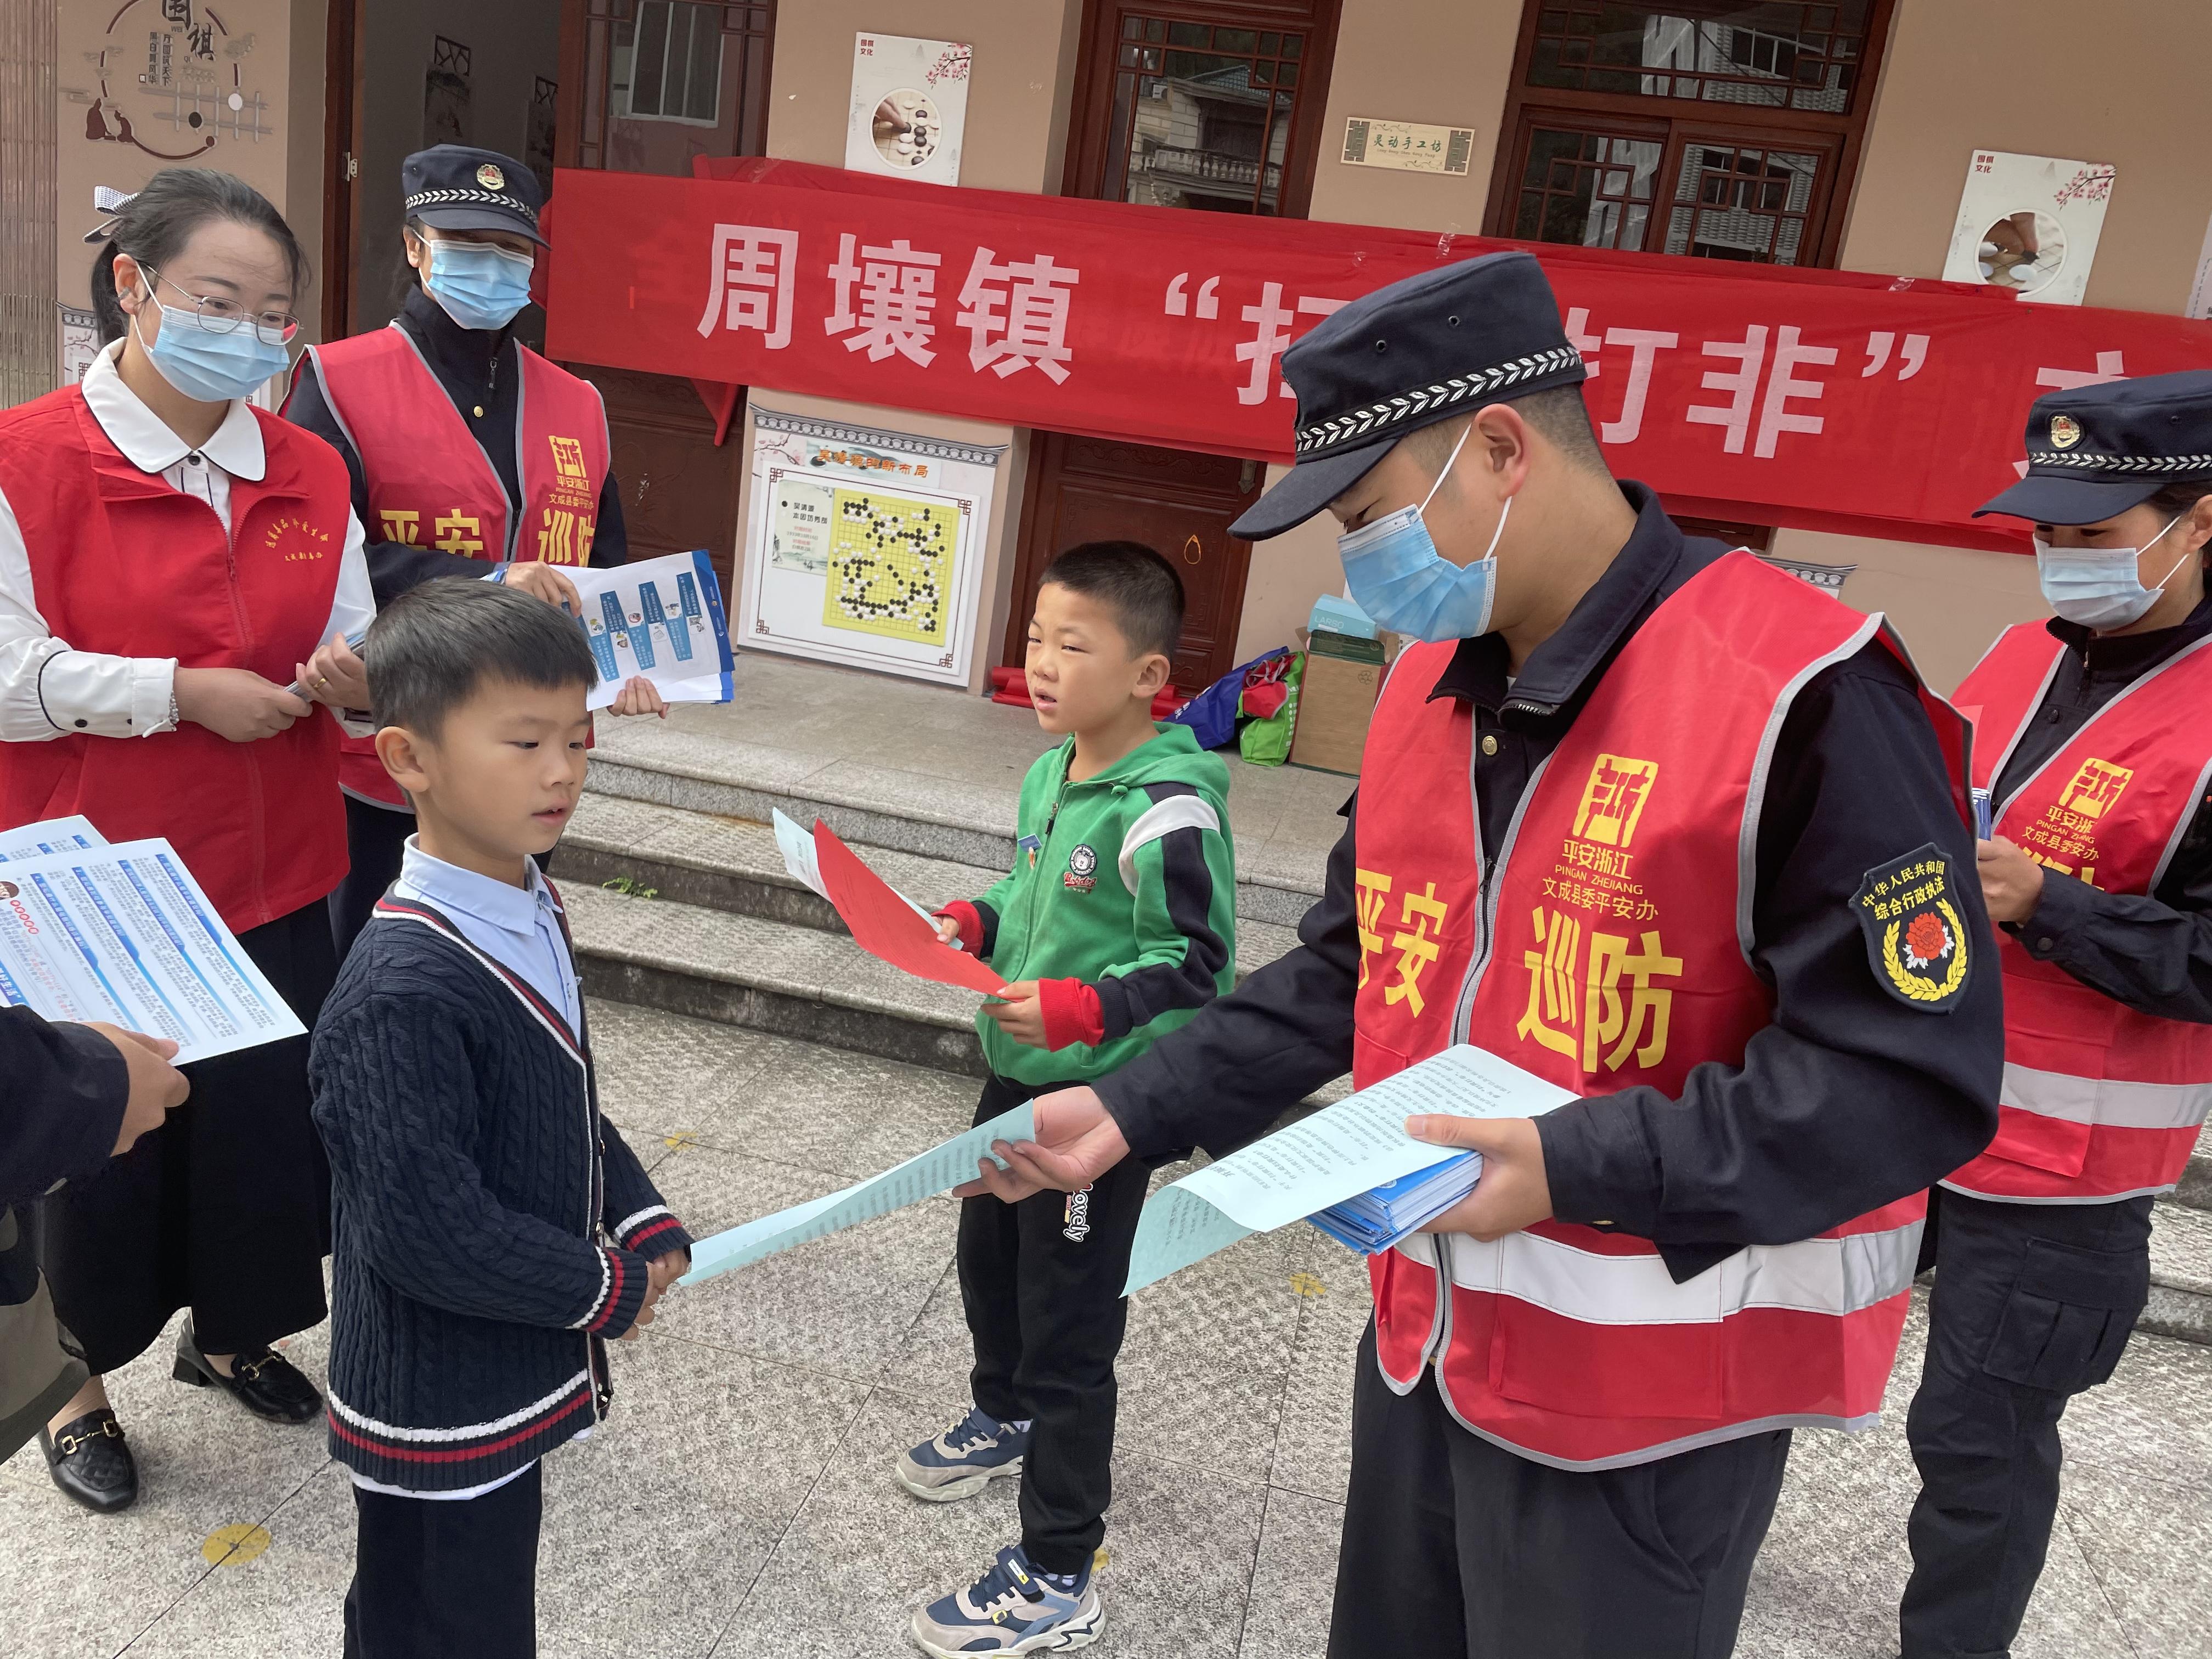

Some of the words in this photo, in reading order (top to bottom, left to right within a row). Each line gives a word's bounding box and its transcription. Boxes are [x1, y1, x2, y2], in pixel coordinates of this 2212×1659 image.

[1374, 134, 1442, 152] 灵动手工坊
[1975, 165, 1991, 173] 文化
[697, 223, 1080, 386] 周壤镇
[2036, 819, 2069, 836] PINGAN
[1555, 864, 1587, 883] PINGAN
[1591, 873, 1644, 896] ZHEJIANG
[1561, 838, 1634, 880] 平安浙江
[1542, 877, 1659, 922] 文成县委平安办
[1862, 860, 1945, 908] 中华人民共和国
[1874, 876, 1945, 921] 综合行政执法
[1516, 905, 1684, 1074] 巡防
[1063, 1183, 1093, 1243] ovely
